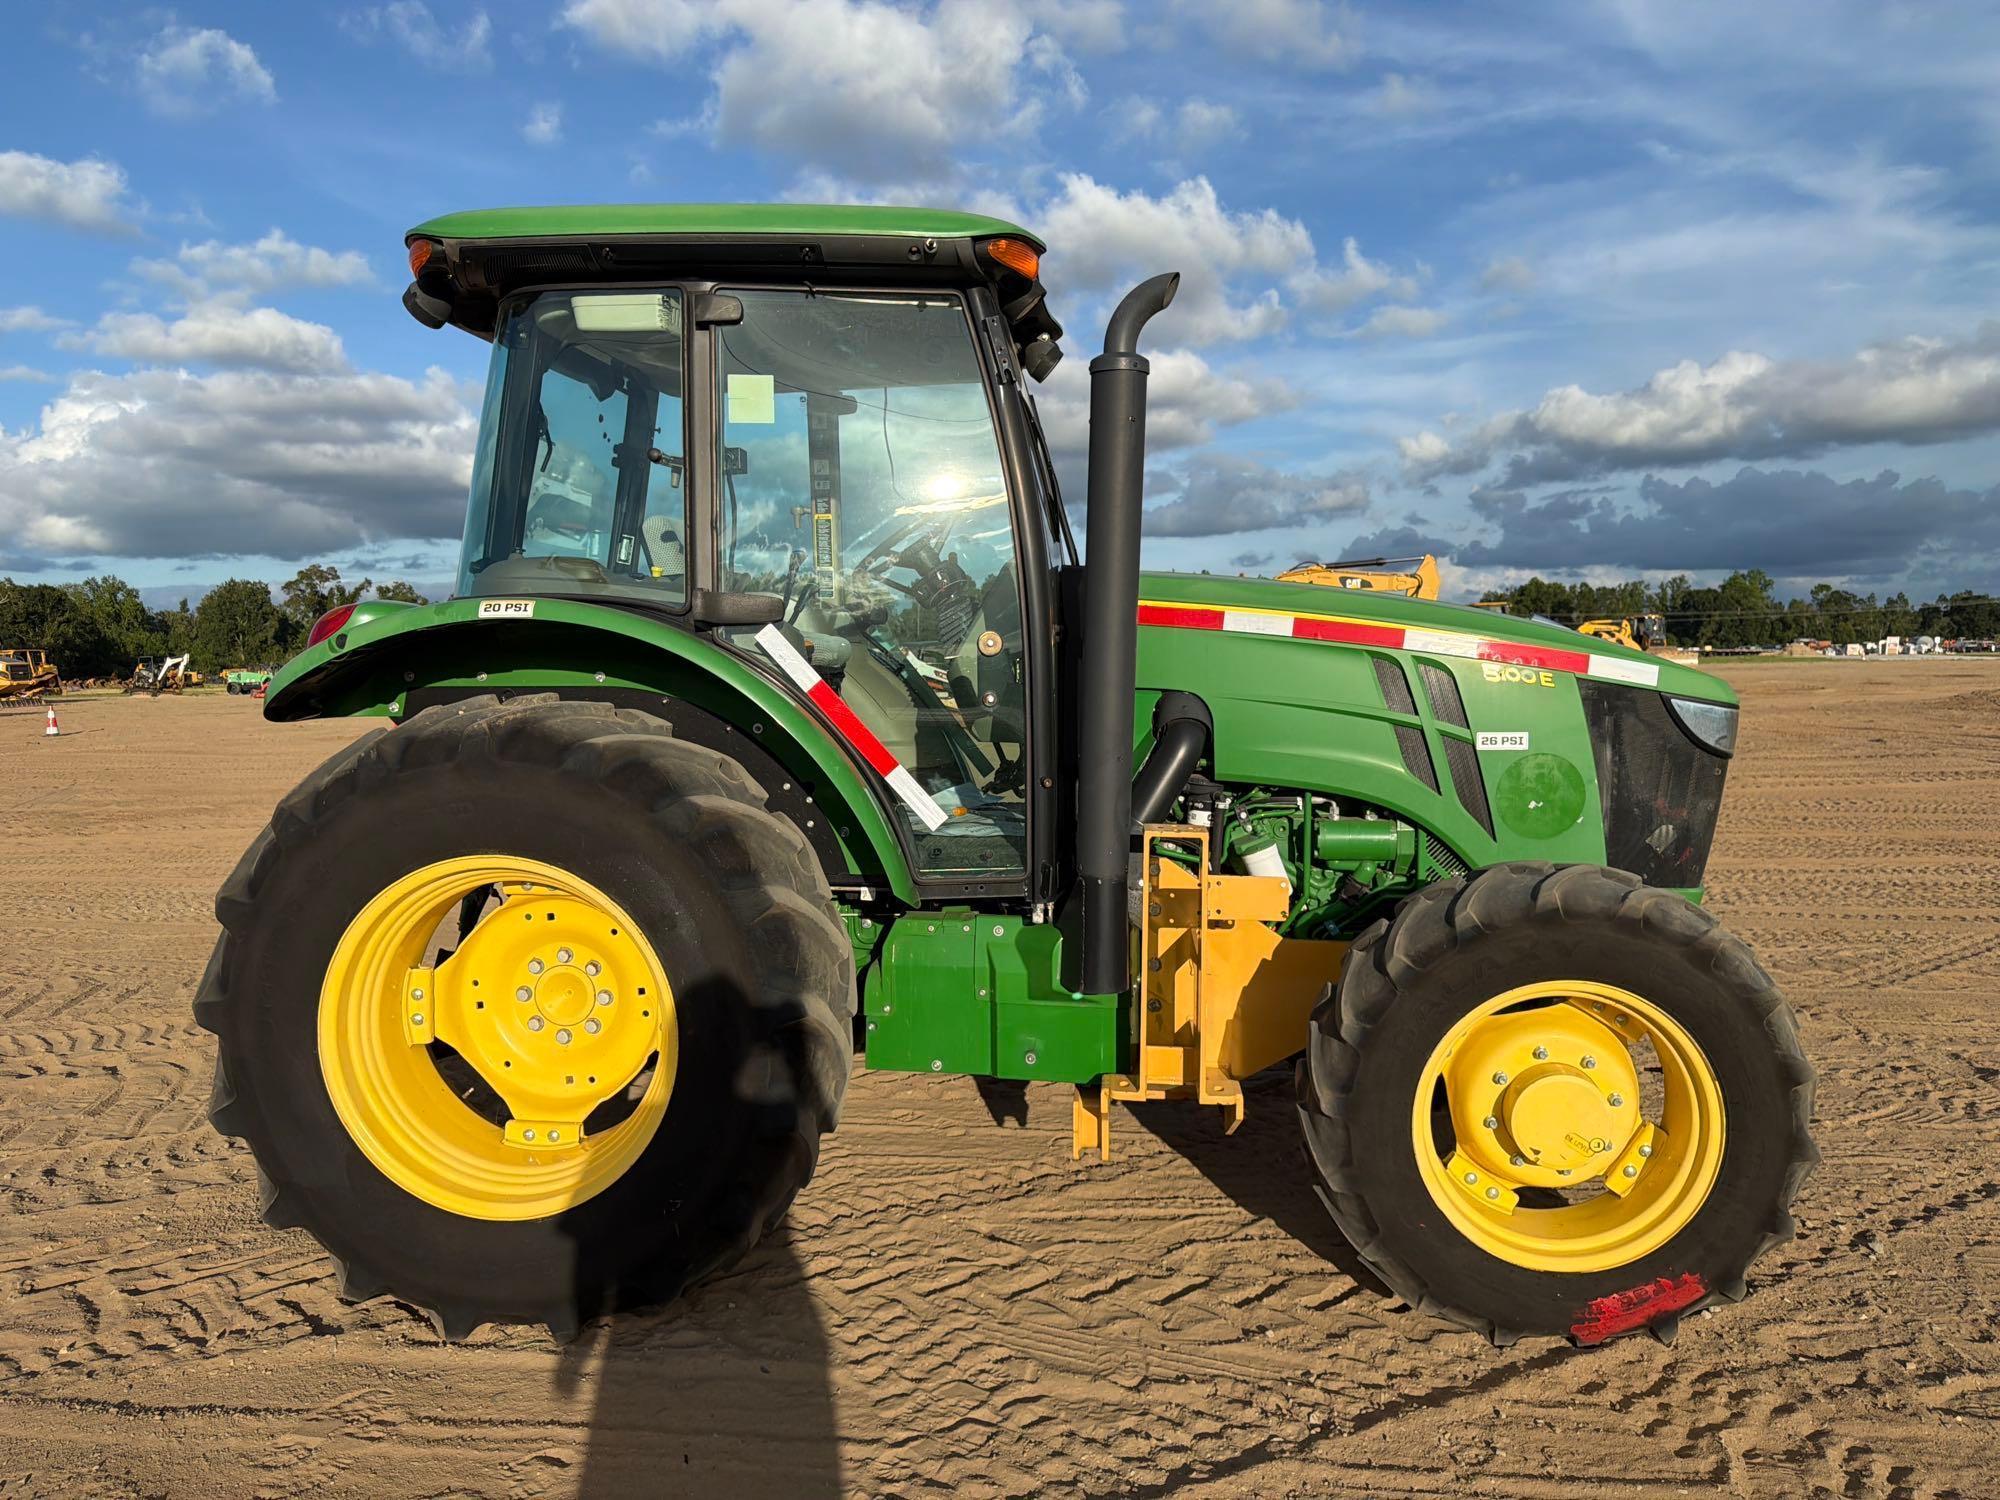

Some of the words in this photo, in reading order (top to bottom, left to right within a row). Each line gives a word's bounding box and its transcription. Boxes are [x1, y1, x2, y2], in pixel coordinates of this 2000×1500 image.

[1346, 578, 1361, 589] CAT
[484, 603, 501, 612] 20
[505, 603, 530, 612] PSI
[1481, 736, 1498, 746] 26
[1501, 736, 1524, 746] PSI
